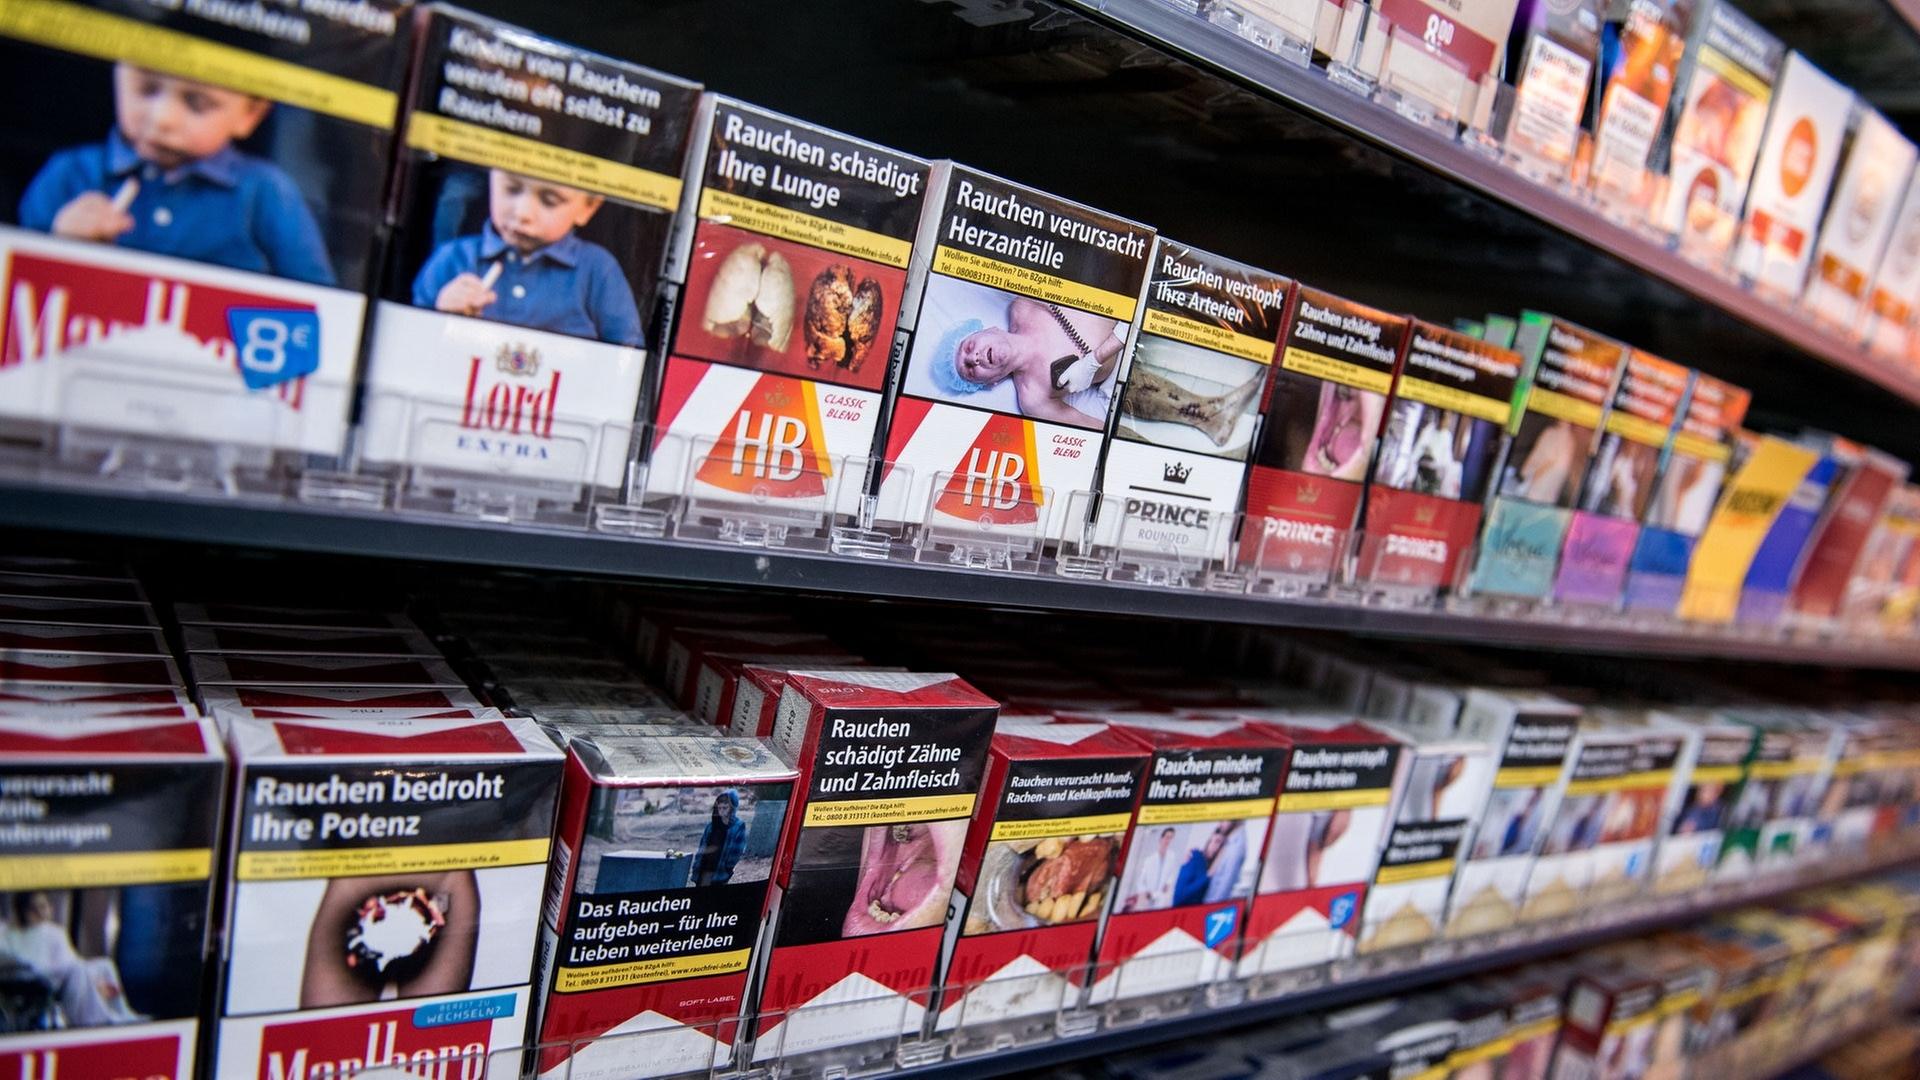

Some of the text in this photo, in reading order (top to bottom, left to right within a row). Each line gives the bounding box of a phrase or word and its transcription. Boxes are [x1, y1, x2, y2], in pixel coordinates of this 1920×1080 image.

[525, 50, 567, 81] von
[568, 61, 661, 109] Rauchern
[438, 87, 543, 137] Rauchern
[444, 61, 651, 136] werden oft selbst zu
[724, 114, 920, 197] Rauchen schädigt
[717, 150, 841, 209] Ihre Lunge
[795, 216, 807, 226] Die
[956, 180, 1145, 260] Rauchen verursacht
[949, 215, 1065, 270] Herzanfälle
[944, 249, 1064, 288] Wollen Sie aufhören? Die BZgA hilft:
[1162, 255, 1283, 310] Rauchen verstopft
[956, 267, 1002, 285] 08008313131
[1003, 279, 1043, 298] (kostenfrei),
[1044, 291, 1114, 315] www.rauchfrei-info.de
[1156, 281, 1244, 324] Ihre Arterien
[1300, 301, 1381, 342] Rauchen schädigt
[1294, 321, 1327, 344] Zähne
[1326, 333, 1348, 350] und
[1346, 335, 1396, 365] Zahnfleisch
[461, 356, 561, 439] Lord
[823, 393, 868, 410] CLASSIC
[826, 409, 861, 422] BLEND
[456, 436, 548, 459] EXTRA
[731, 410, 807, 482] HB
[1052, 434, 1087, 448] CLASSIC
[1053, 447, 1081, 459] BLEND
[964, 448, 1025, 511] HB
[1126, 500, 1209, 530] PRINCE
[1138, 528, 1189, 544] ROUNDED
[1263, 516, 1335, 546] PRINCE
[1386, 533, 1447, 563] PRINCE
[831, 717, 911, 739] Rauchen
[825, 744, 961, 769] schädigt Zähne
[1154, 754, 1263, 776] Rauchen mindert
[256, 771, 505, 807] Rauchen bedroht
[820, 768, 960, 792] und Zahnfleisch
[1011, 771, 1133, 788] Rauchen verursacht Mund-,
[1148, 778, 1262, 800] Ihre Fruchtbarkeit
[1006, 787, 1131, 804] Rachen- und Kehlkopfkrebs
[251, 813, 421, 842] Ihre Potenz
[848, 812, 870, 820] 313131
[907, 806, 968, 816] www.rauchfrei-info.de
[578, 896, 691, 918] Das Rauchen
[574, 919, 659, 943] aufgeben
[678, 915, 703, 933] für
[706, 913, 738, 928] Ihre
[569, 934, 734, 963] Lieben weiterleben
[565, 980, 580, 988] Tel.:
[605, 975, 628, 983] 313131
[630, 969, 669, 980] (kostenfrei),
[671, 961, 742, 975] www.rauchfrei-info.de
[601, 966, 632, 975] aufhören?
[645, 963, 660, 971] BZgA
[427, 1006, 500, 1024] WECHSELN?
[680, 995, 736, 1007] SOFT LABEL
